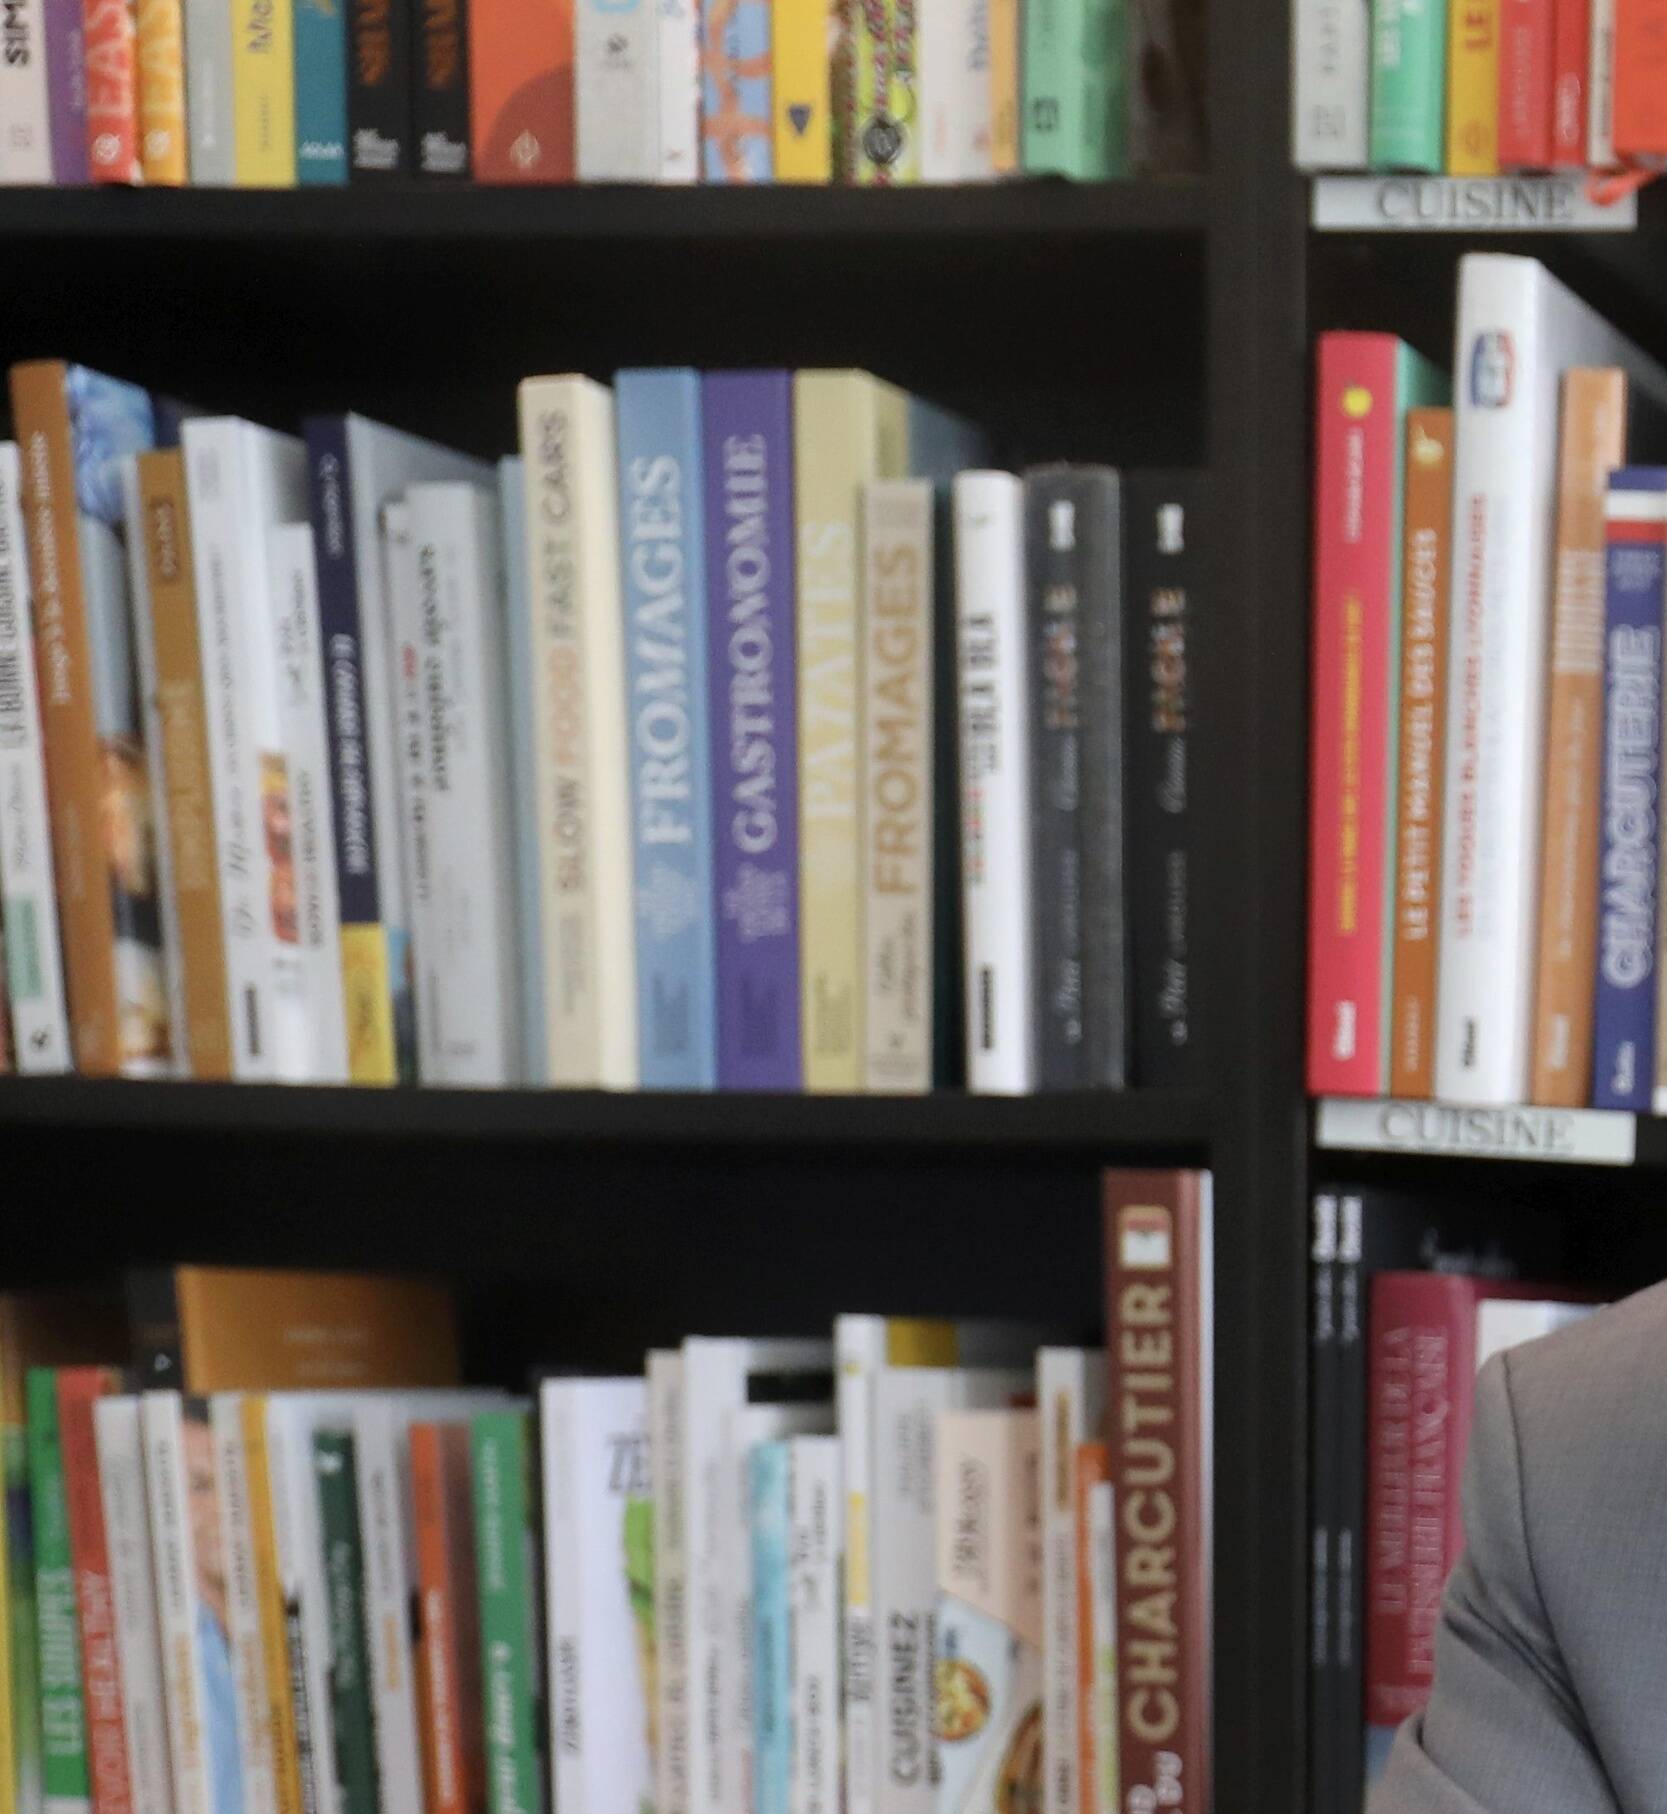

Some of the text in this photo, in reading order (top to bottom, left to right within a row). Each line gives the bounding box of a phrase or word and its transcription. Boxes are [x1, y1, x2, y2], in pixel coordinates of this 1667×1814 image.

[1376, 177, 1574, 222] CUISINE
[542, 406, 590, 893] SLOW FOOD FAST CARS
[630, 453, 693, 848] FROMAGES
[721, 431, 778, 856] GASTRONOMIE
[1412, 530, 1437, 642] SAUCES
[873, 543, 922, 897] FROMAGES
[1411, 647, 1435, 702] DES
[1408, 709, 1434, 824] MANUEL
[1603, 623, 1663, 990] CHARCUTERIE
[1407, 828, 1432, 908] PETIT
[1379, 1102, 1575, 1153] CUISINE
[1124, 1283, 1181, 1747] CHARCUTIER
[888, 1610, 923, 1790] CUISINEZ
[1156, 1752, 1186, 1810] DU
